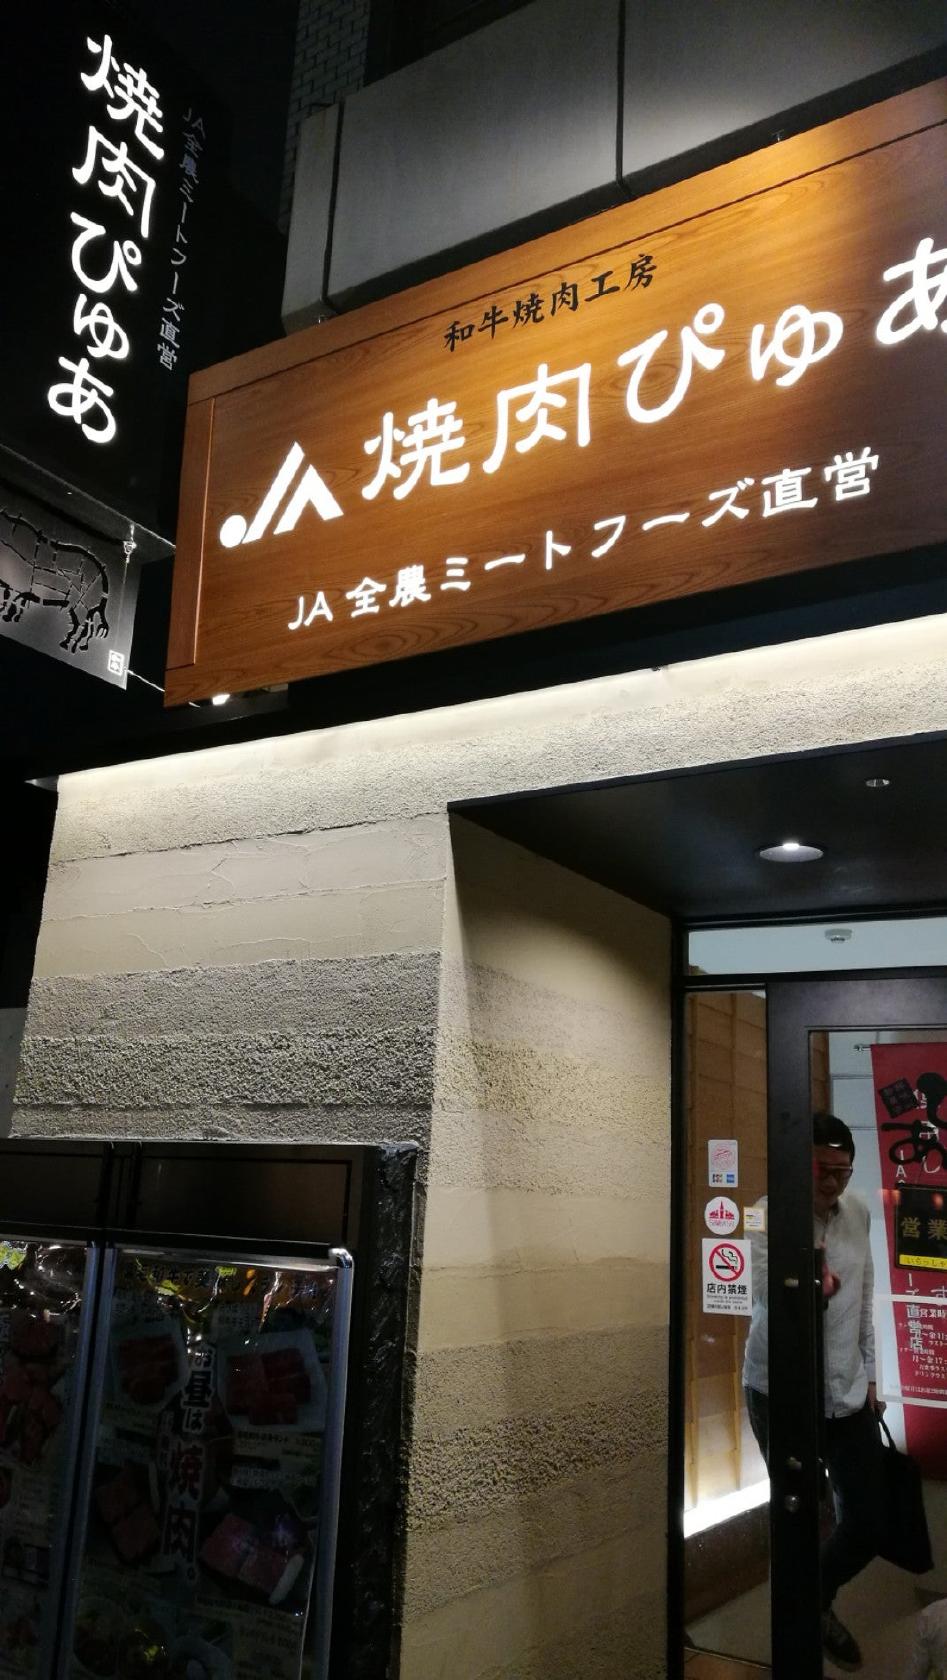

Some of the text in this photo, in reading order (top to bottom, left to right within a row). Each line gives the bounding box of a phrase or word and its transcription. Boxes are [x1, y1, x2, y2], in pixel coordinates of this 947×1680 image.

[48, 35, 165, 443] 焼肉ぴゅあ
[443, 253, 657, 352] 和牛焼肉工房
[361, 237, 947, 501] 焼肉ぴゅあ
[706, 1282, 748, 1295] 店内禁煙
